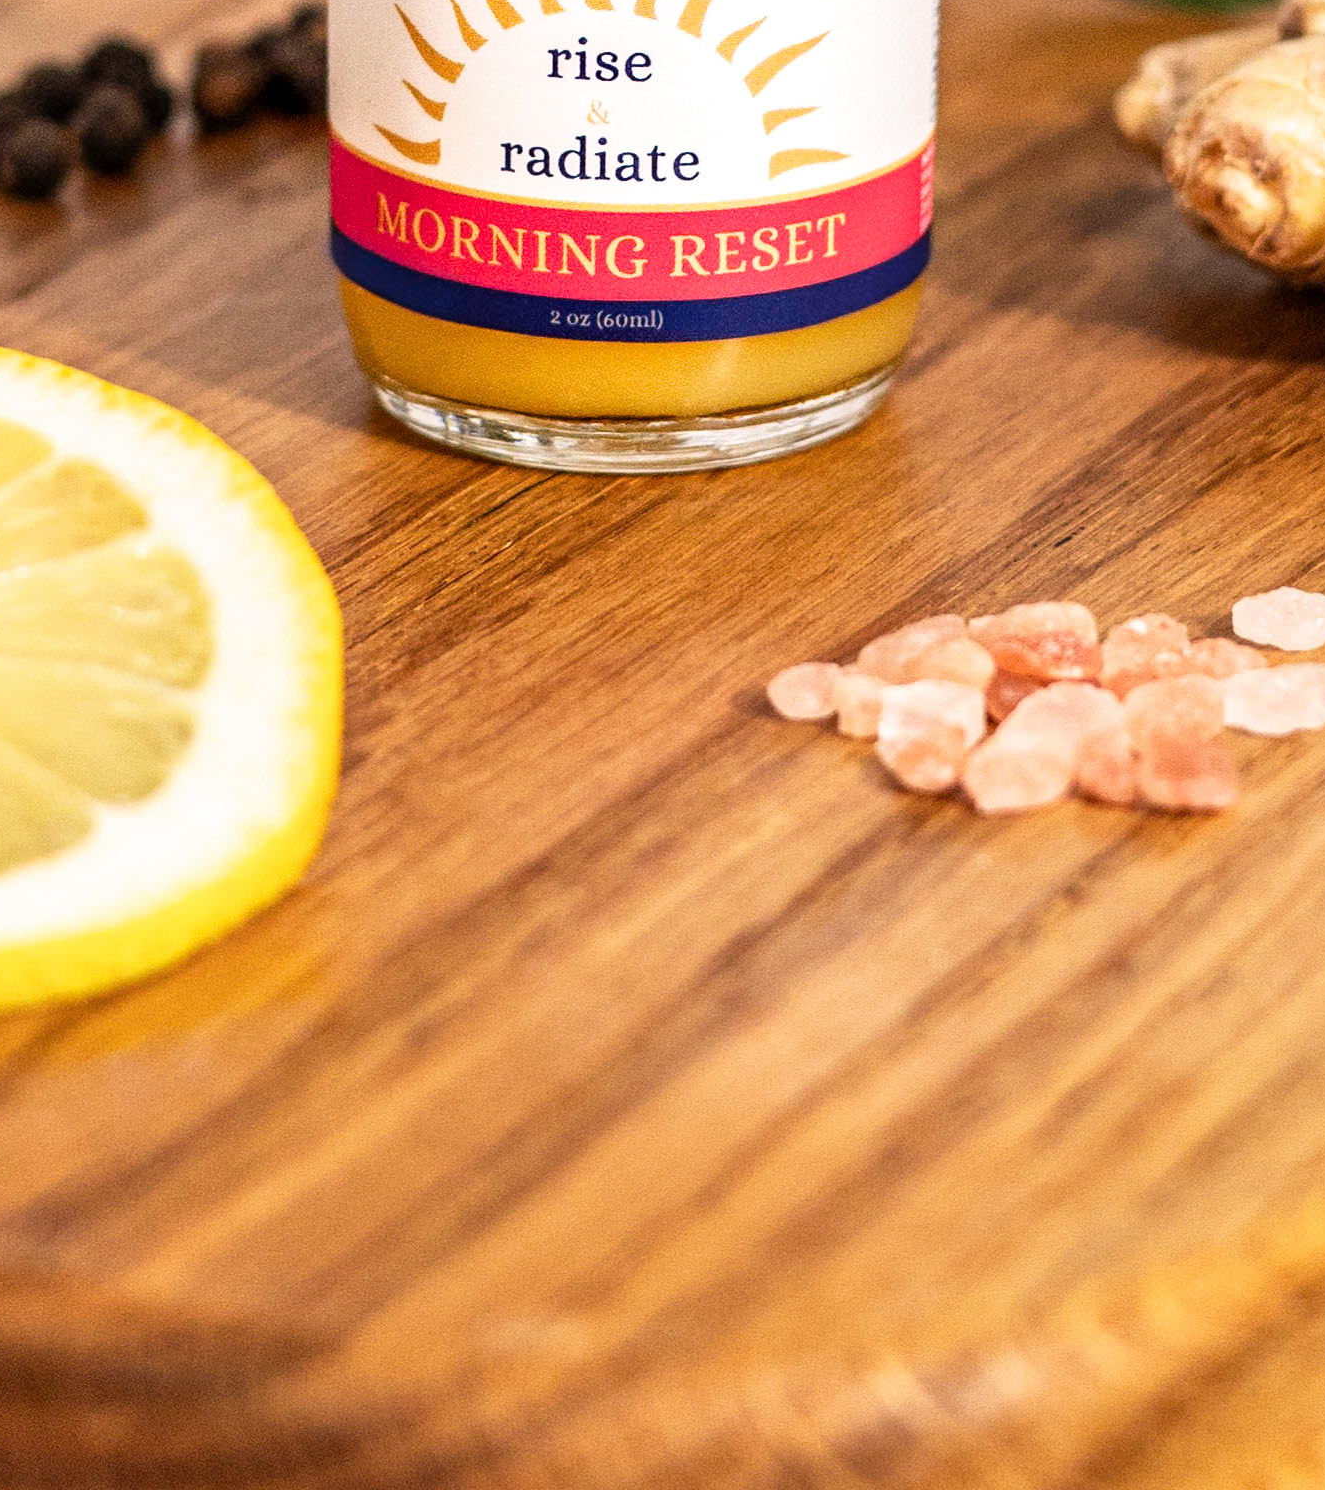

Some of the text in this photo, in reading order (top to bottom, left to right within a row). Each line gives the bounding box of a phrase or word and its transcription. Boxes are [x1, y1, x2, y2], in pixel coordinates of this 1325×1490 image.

[547, 36, 653, 82] rise
[586, 98, 610, 125] &
[500, 135, 700, 182] radiate
[377, 191, 846, 279] MORNING RESET
[550, 308, 664, 331] 2 oz (60ml)
